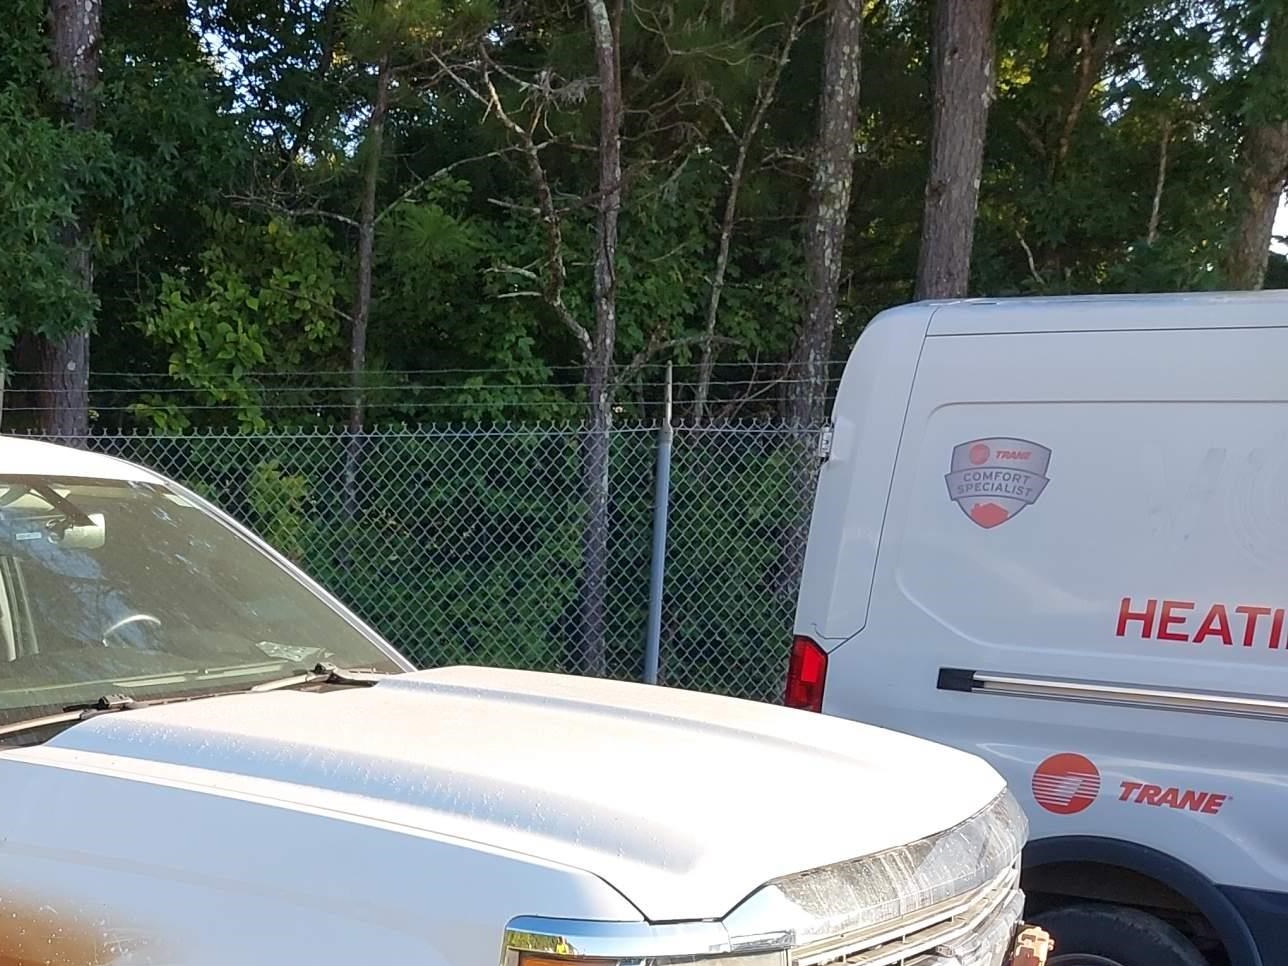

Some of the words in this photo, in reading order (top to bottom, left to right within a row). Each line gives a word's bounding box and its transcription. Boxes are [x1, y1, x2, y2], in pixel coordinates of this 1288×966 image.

[995, 450, 1032, 460] TRANE
[963, 471, 1033, 485] COMFORT
[956, 482, 1033, 497] SPECIALIST
[1115, 597, 1288, 650] HEATI
[1118, 781, 1227, 815] TRANE
